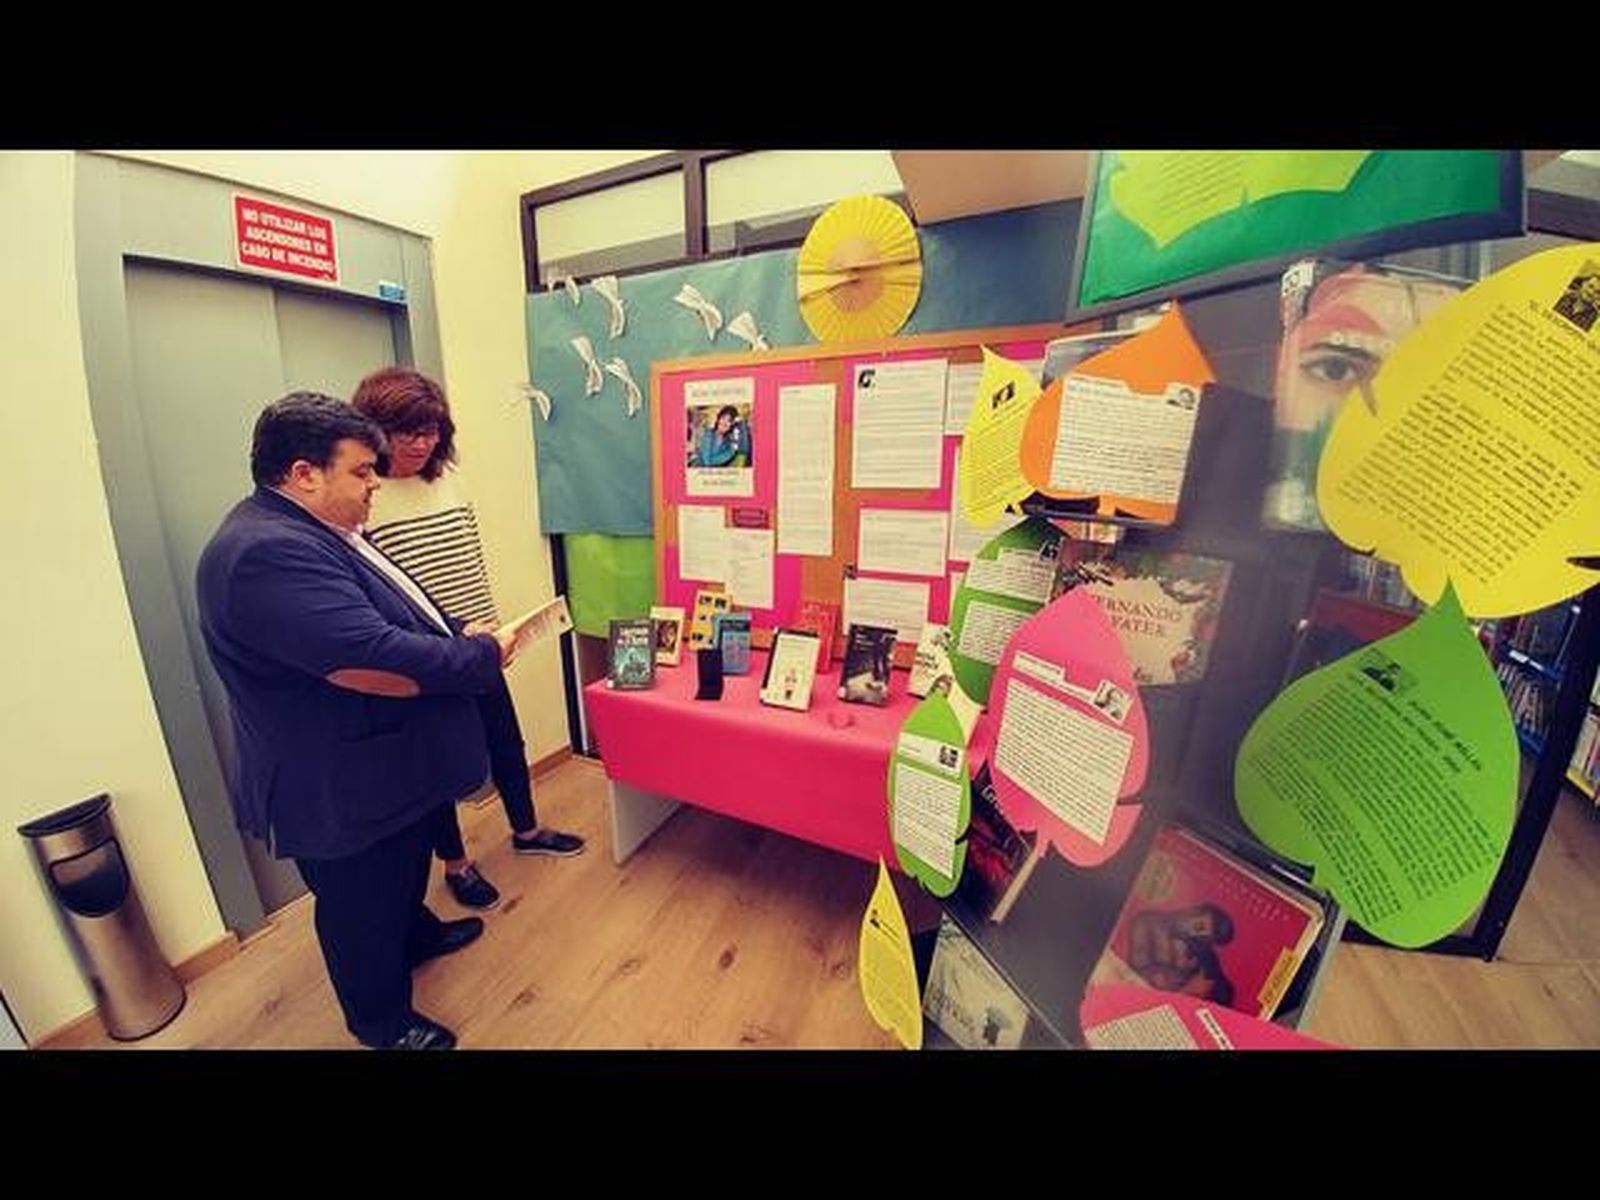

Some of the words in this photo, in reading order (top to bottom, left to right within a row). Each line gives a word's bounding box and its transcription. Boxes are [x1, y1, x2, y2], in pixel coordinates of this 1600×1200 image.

[242, 208, 258, 223] NO
[260, 211, 306, 234] UTILIZAR
[246, 226, 311, 252] ASCENSORES
[313, 240, 328, 256] EN
[241, 240, 271, 260] CASO
[272, 247, 286, 264] DE
[287, 252, 334, 274] INCENDIO
